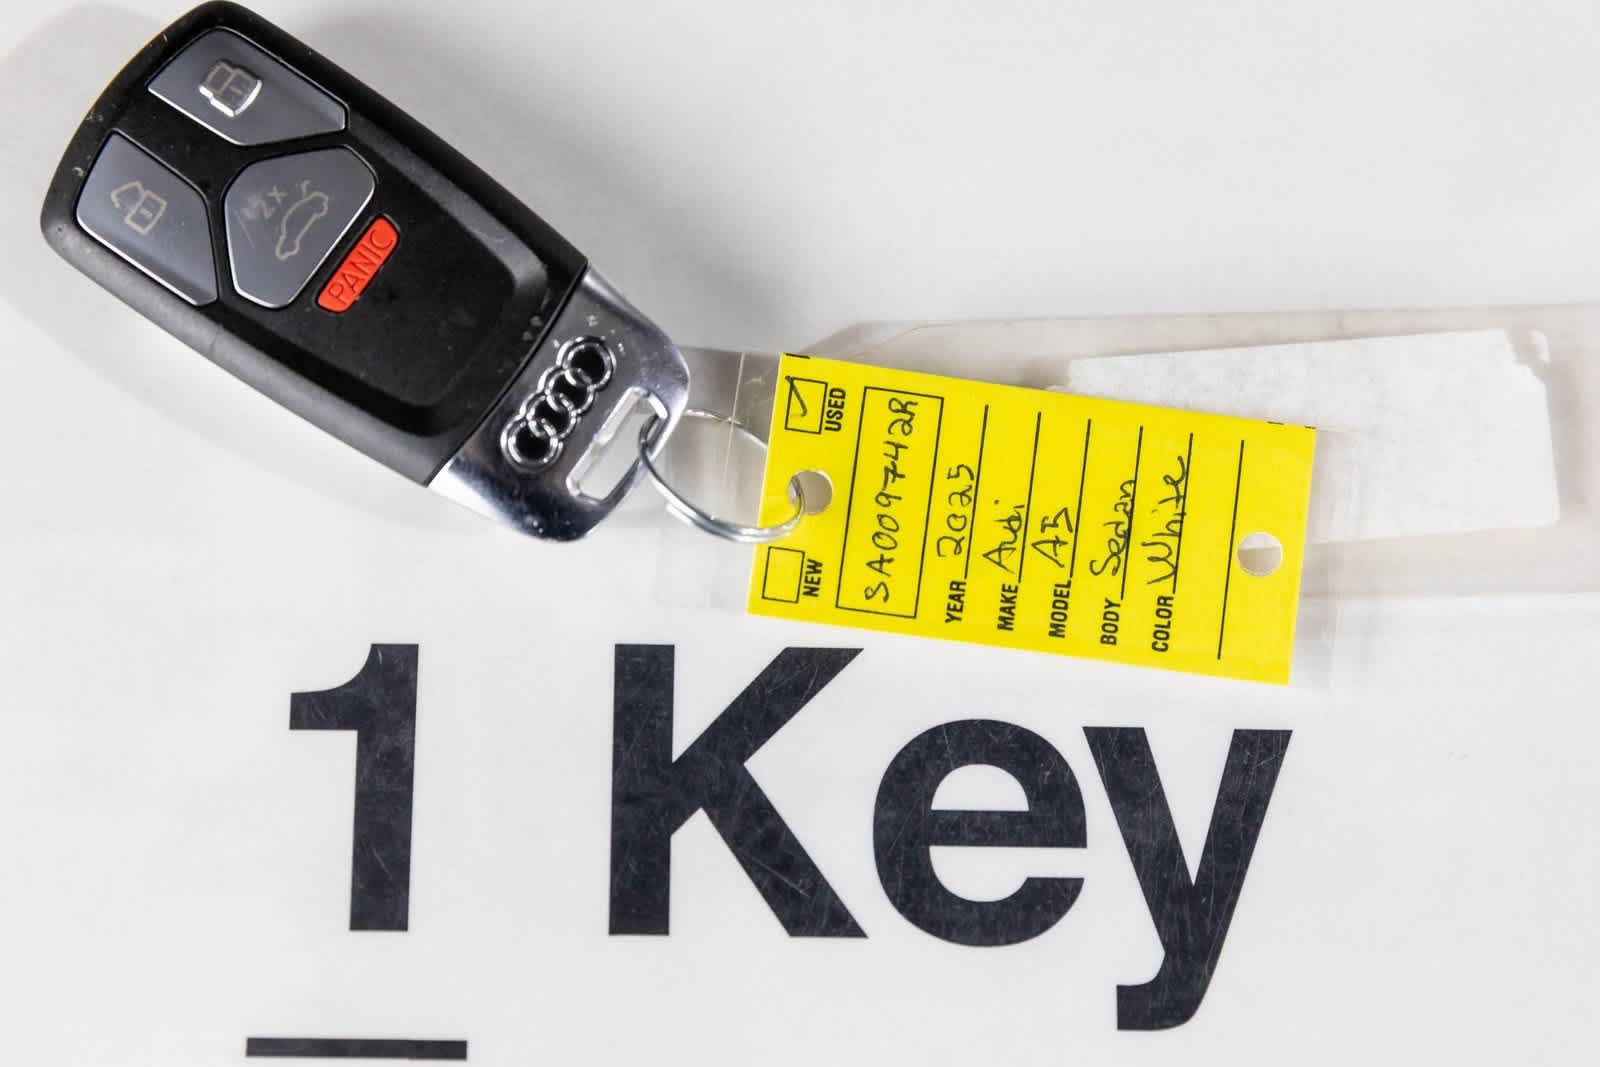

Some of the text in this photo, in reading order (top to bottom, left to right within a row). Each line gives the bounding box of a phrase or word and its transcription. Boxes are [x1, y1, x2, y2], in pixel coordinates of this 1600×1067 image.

[328, 229, 394, 304] PANIC
[824, 387, 847, 432] USED
[803, 558, 823, 598] NEW
[937, 463, 975, 623] YEAR 2025
[982, 499, 1025, 631] MAKE Audi
[1048, 580, 1072, 638] MODEL
[1089, 479, 1136, 646] BODY Sedan
[1141, 455, 1187, 652] COLOR White
[290, 643, 1293, 1031] 1 Key
